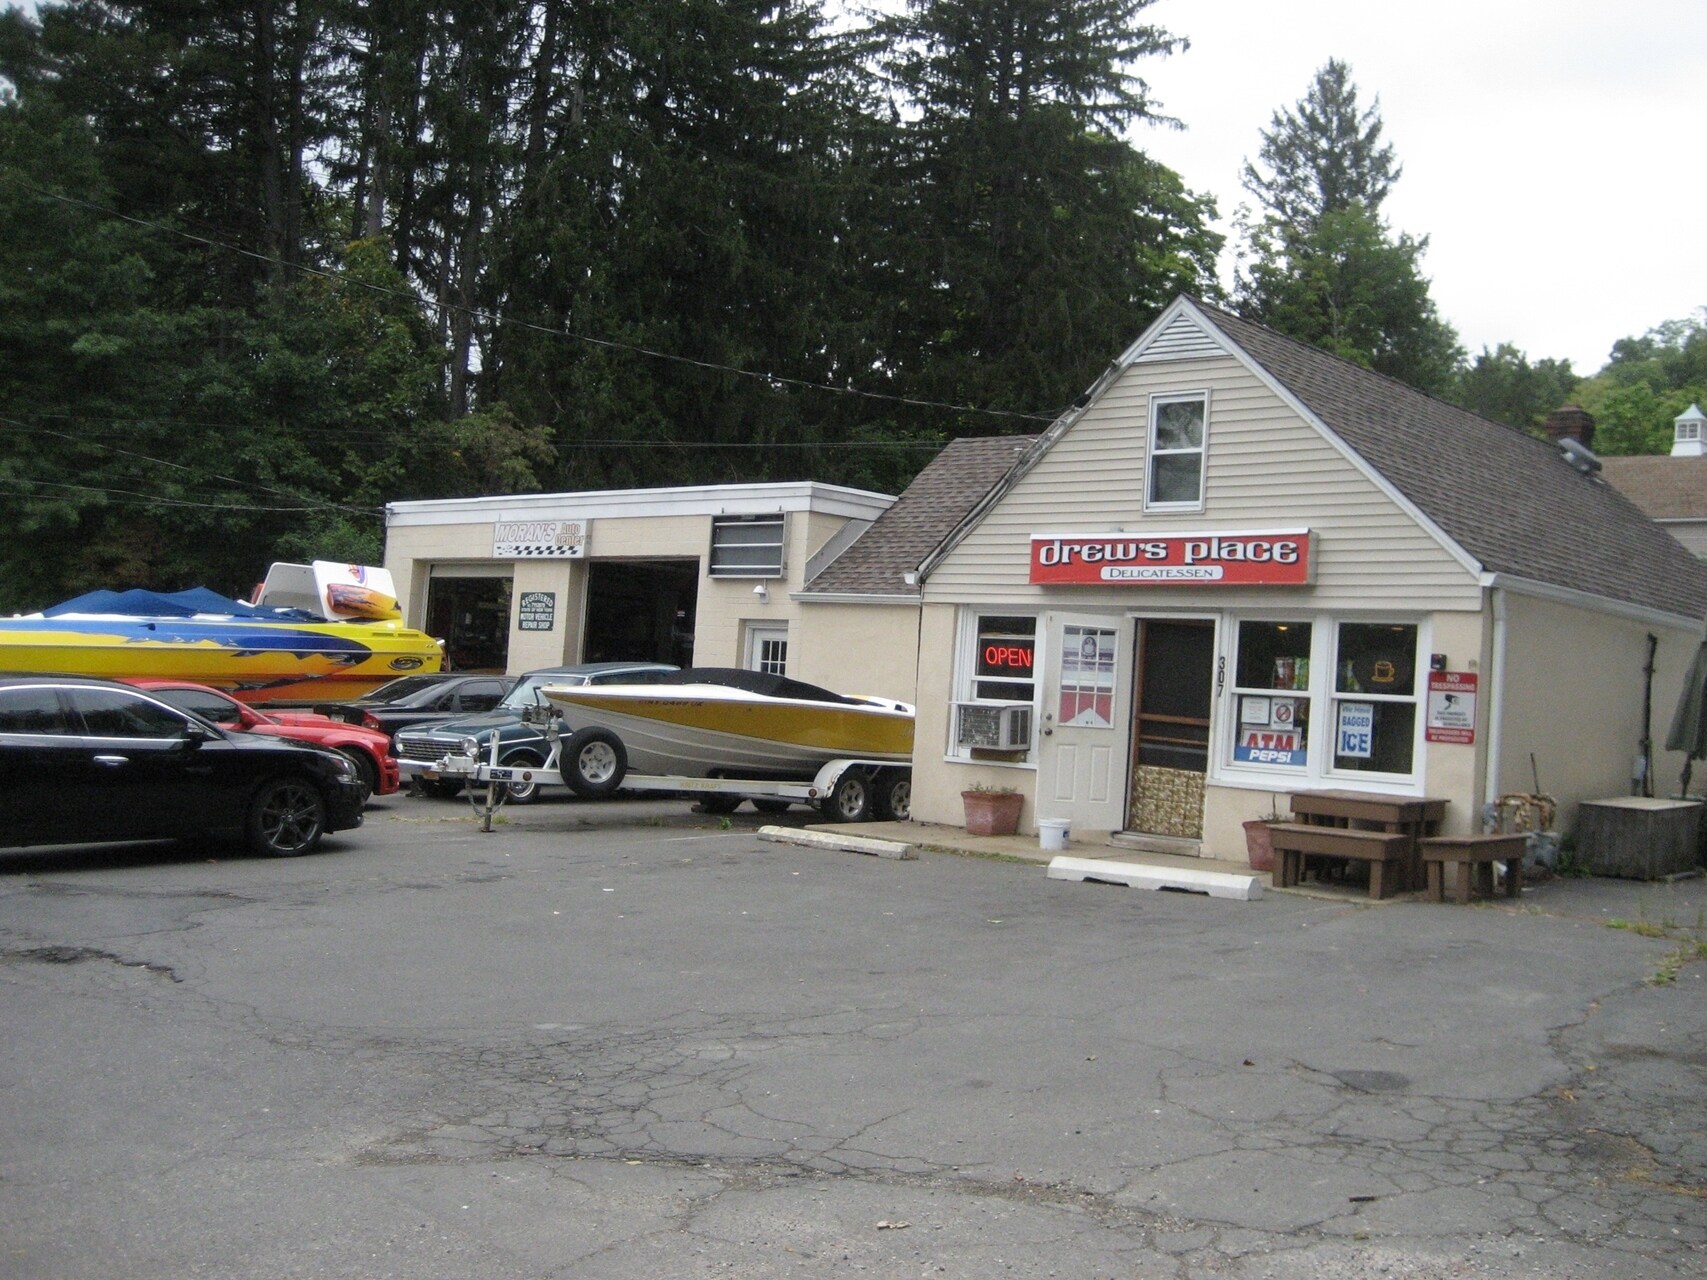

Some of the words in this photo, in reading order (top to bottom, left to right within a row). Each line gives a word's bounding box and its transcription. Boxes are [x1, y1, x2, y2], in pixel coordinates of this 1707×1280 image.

[495, 523, 556, 543] MORAN'S
[561, 522, 581, 534] Auto
[555, 534, 584, 547] Center
[1039, 539, 1168, 566] drew's
[1184, 537, 1298, 565] place
[1109, 567, 1214, 578] DELICATESSEN
[521, 593, 554, 607] REGISTERED
[535, 613, 553, 621] VEHICLE
[522, 621, 537, 629] REPAIR
[538, 621, 550, 629] SHOP
[985, 646, 1032, 667] OPEN
[1217, 656, 1226, 697] 307
[1446, 673, 1460, 683] NO
[1431, 682, 1475, 691] TRESPASSING
[1342, 715, 1371, 727] BAGGED
[1246, 733, 1295, 750] ATM
[1341, 731, 1369, 752] ICE
[1248, 749, 1292, 763] PEPSI
